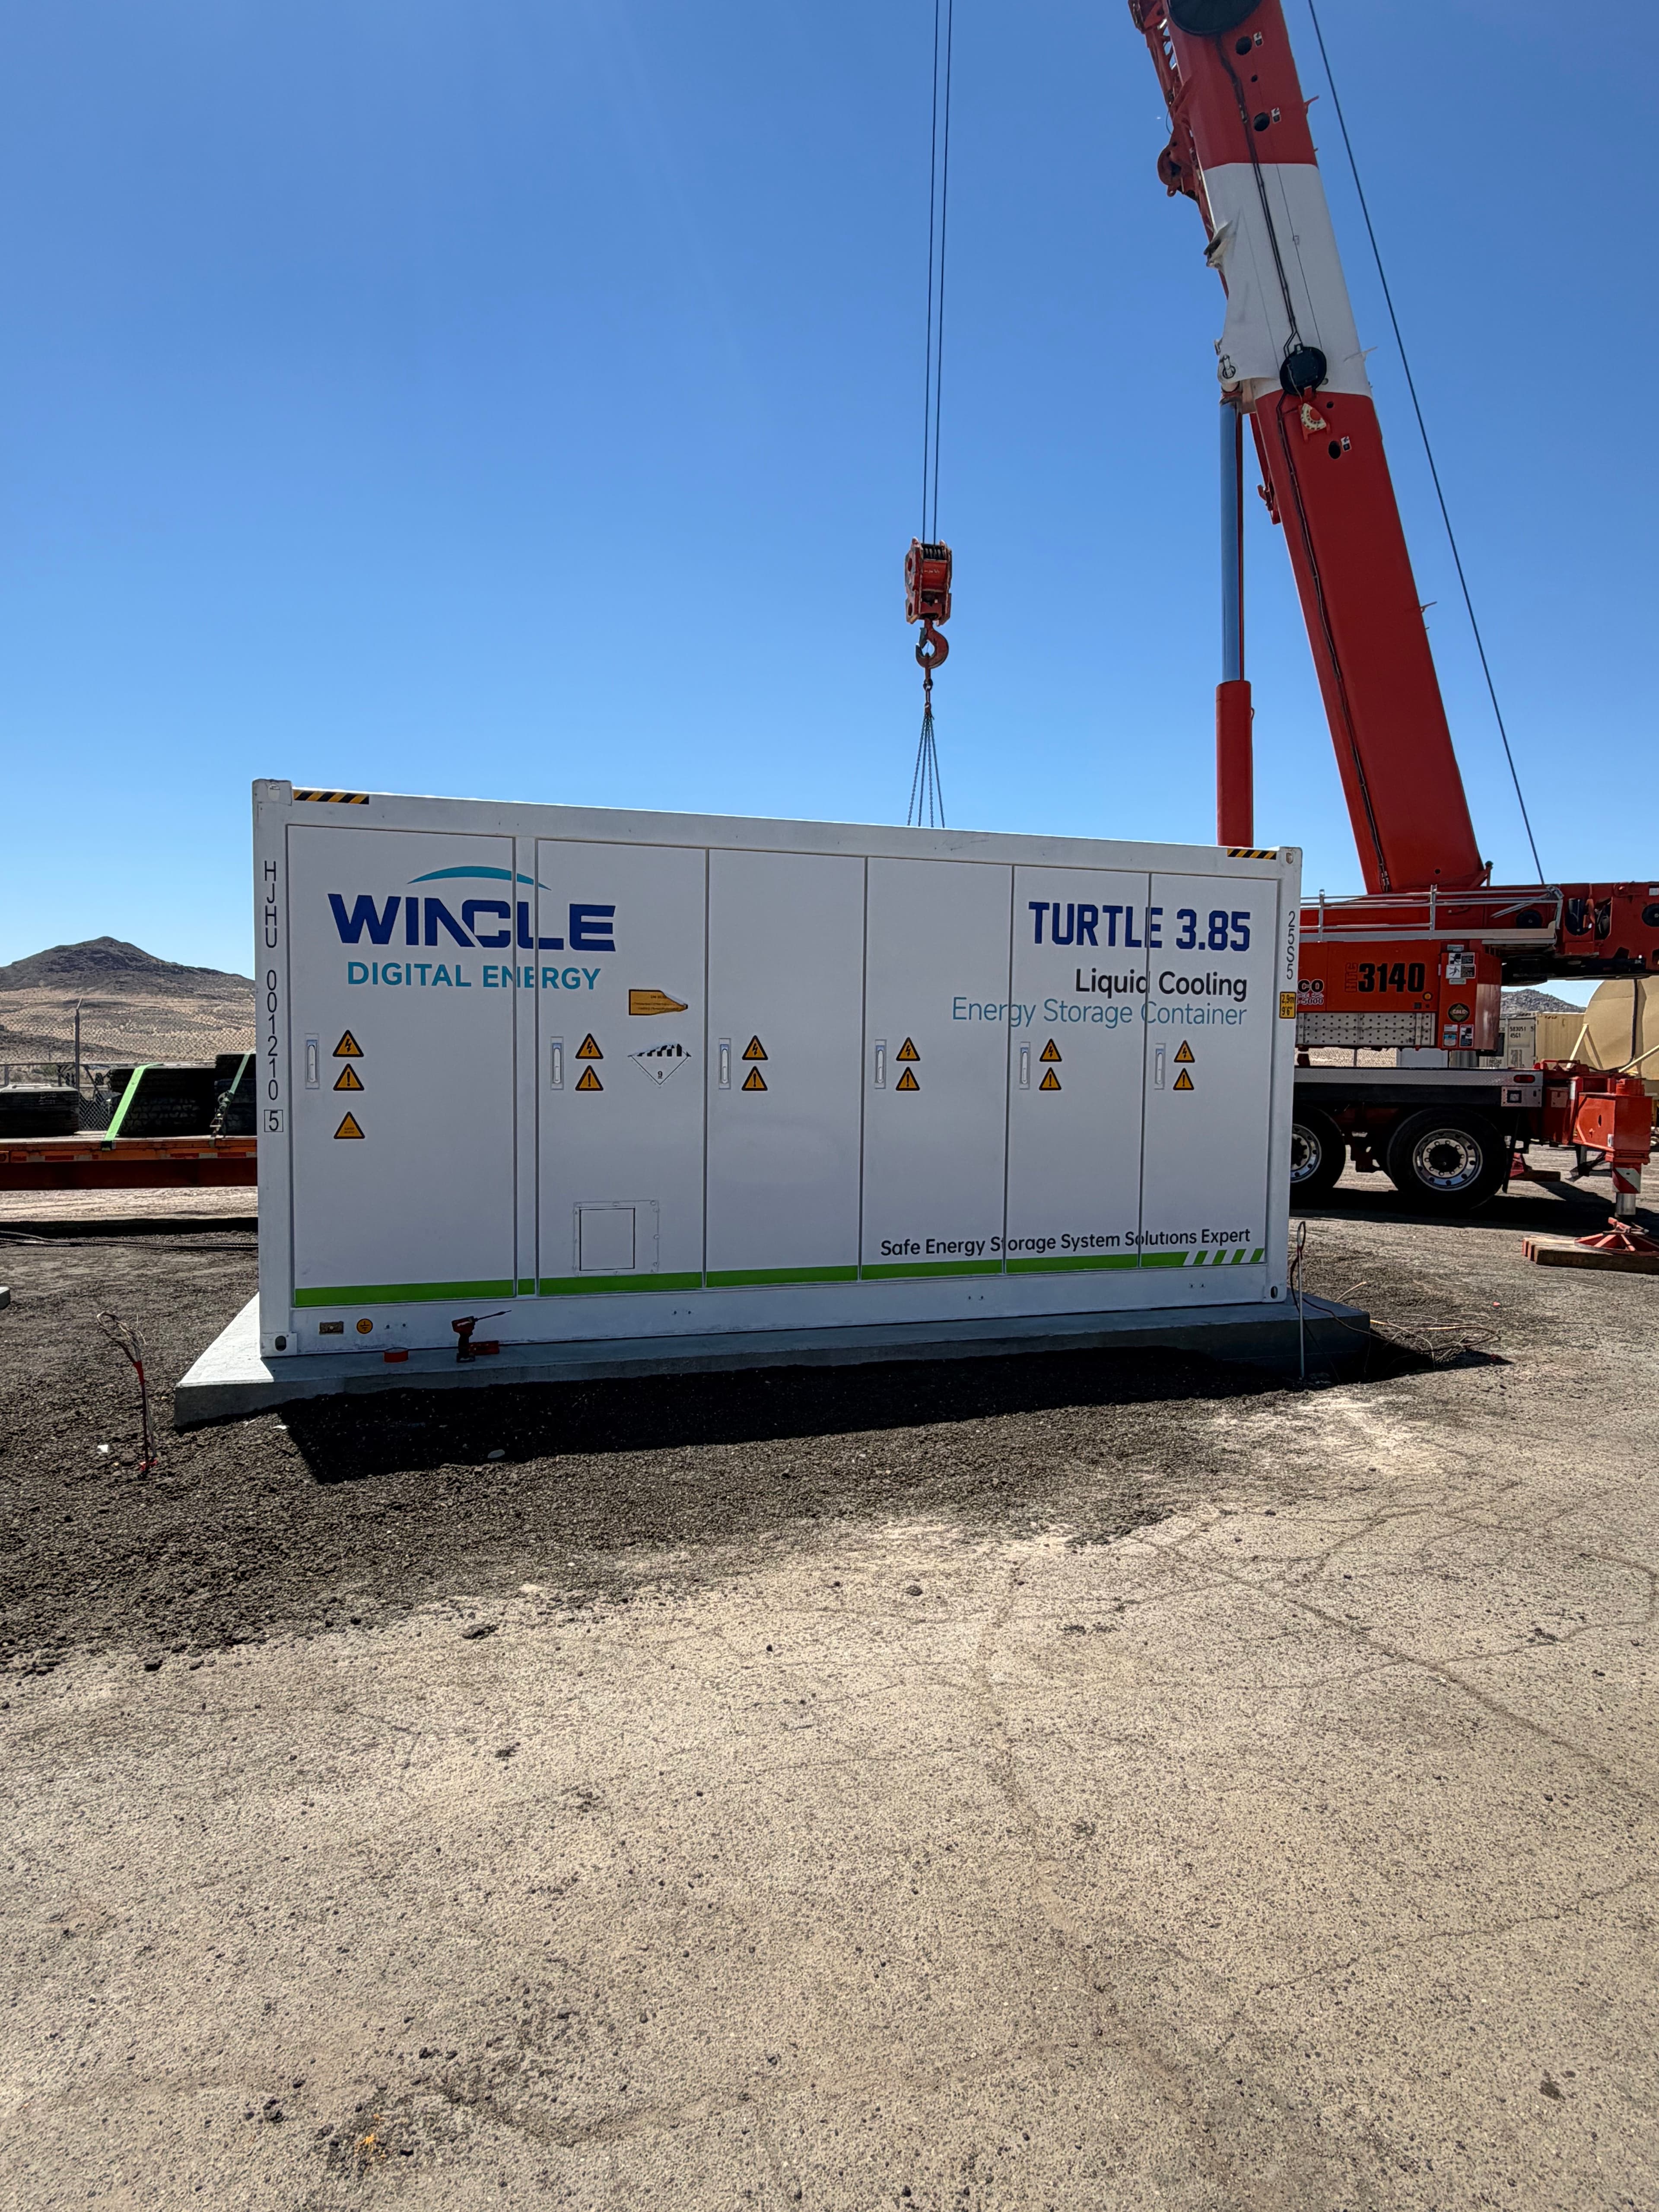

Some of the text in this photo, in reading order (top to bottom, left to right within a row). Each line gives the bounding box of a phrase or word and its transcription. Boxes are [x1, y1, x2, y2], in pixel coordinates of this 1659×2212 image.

[327, 893, 616, 952] WINCLE
[1028, 901, 1251, 951] TURTLE 3.85
[348, 961, 601, 990] DIGITAL ENERGY
[1076, 968, 1247, 1002] Liquid Cooling
[1297, 979, 1324, 993] CO
[1358, 963, 1425, 992] 3140
[265, 860, 279, 1131] HJHU 001210 5
[953, 996, 1247, 1029] Energy Storage Container
[880, 1239, 921, 1256] Safe
[925, 1238, 985, 1256] Energy
[1061, 1233, 1120, 1252] System
[1125, 1230, 1197, 1246] Solutions
[1201, 1228, 1251, 1246] Expert
